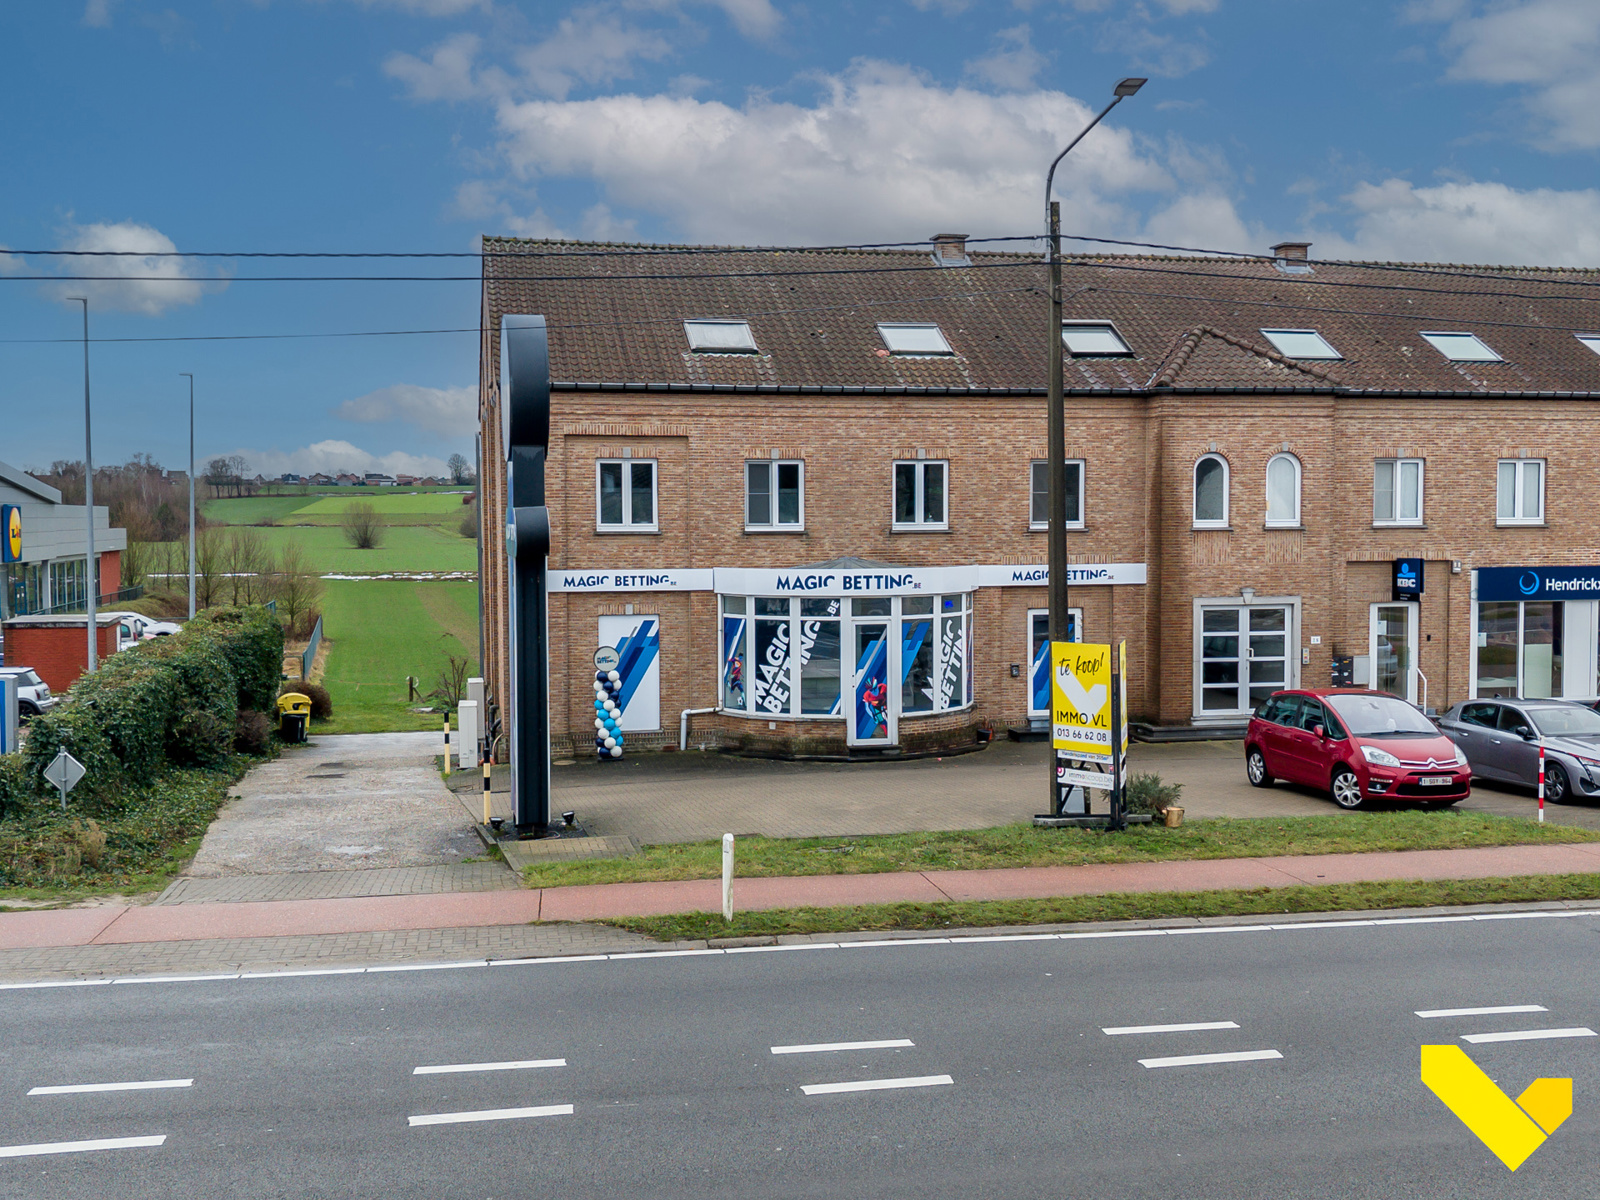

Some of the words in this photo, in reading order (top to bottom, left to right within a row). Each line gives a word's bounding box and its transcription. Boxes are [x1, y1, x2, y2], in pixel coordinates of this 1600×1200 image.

[563, 576, 609, 587] MAGIC
[776, 575, 835, 590] MAGIC
[1397, 578, 1416, 588] KBC
[1059, 658, 1071, 676] te
[1075, 652, 1105, 676] koop!
[1056, 710, 1089, 725] IMMO
[1091, 713, 1107, 727] VL
[1057, 727, 1070, 738] 013
[1072, 729, 1082, 739] 66
[1084, 731, 1094, 741] 62
[1096, 732, 1107, 742] 08
